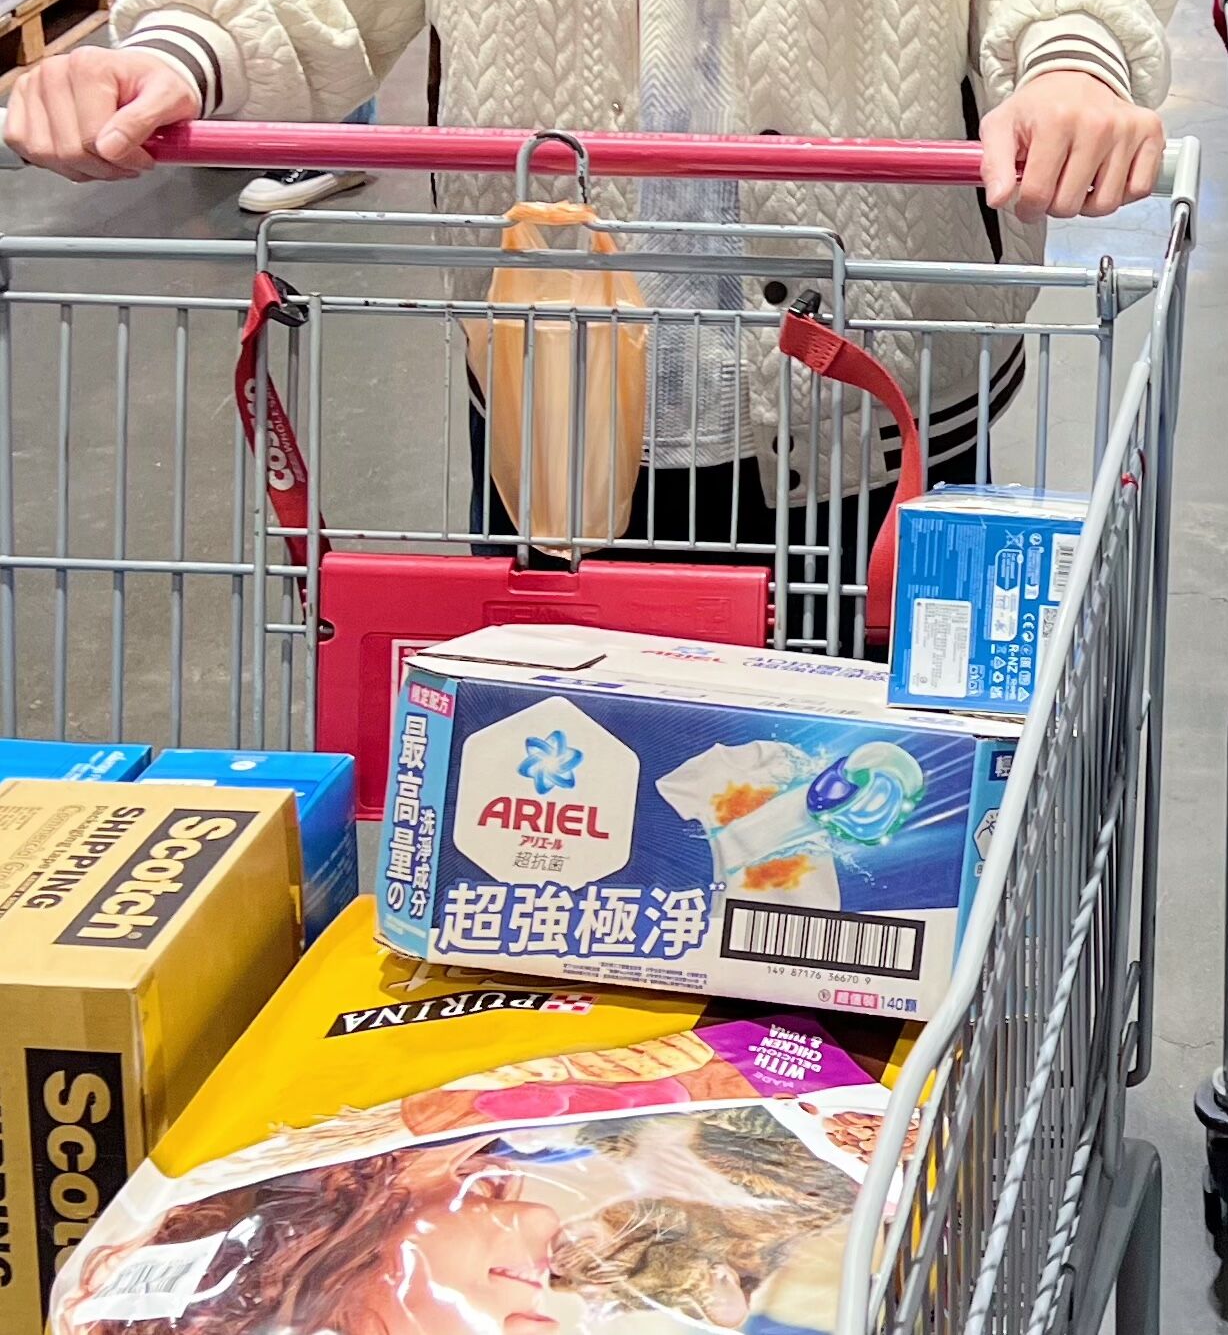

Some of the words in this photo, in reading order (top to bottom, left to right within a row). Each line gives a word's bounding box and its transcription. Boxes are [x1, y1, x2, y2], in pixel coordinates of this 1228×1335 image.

[386, 715, 428, 910] 最高量の
[477, 796, 610, 840] ARIEL
[519, 835, 563, 851] アリエール
[22, 806, 147, 910] SHIPPING
[512, 851, 565, 873] 超抗菌
[76, 815, 238, 940] Scotch
[438, 881, 708, 956] 超強極淨
[342, 992, 546, 1033] PURINA
[768, 1023, 807, 1045] TUNA
[747, 1044, 822, 1073] DELICIOUS
[760, 1036, 823, 1062] CHICKEN
[751, 1071, 795, 1089] MADE
[753, 1054, 806, 1081] WITH
